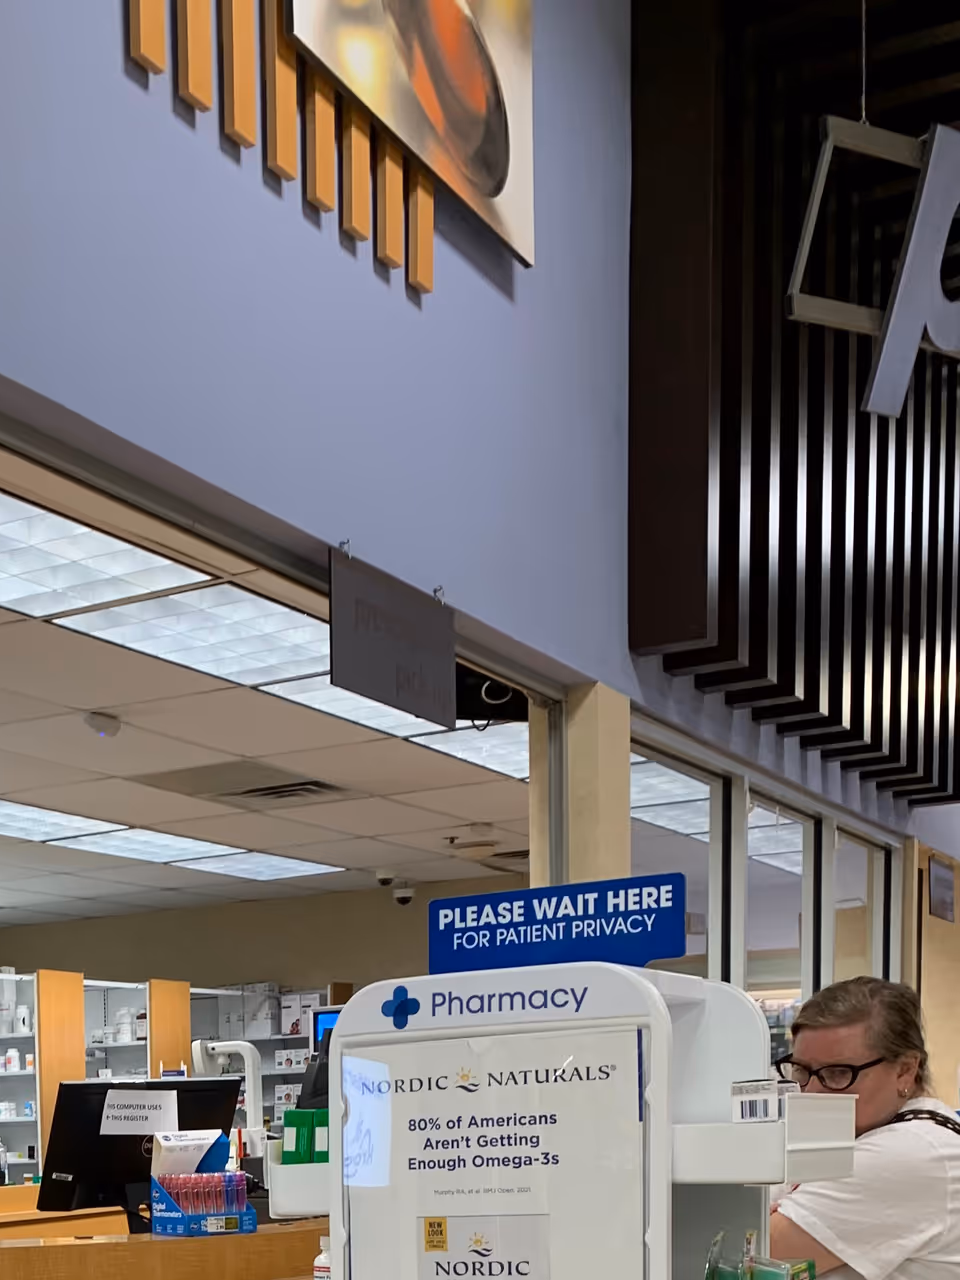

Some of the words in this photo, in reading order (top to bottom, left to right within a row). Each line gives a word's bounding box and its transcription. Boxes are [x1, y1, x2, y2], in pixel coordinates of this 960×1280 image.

[439, 900, 525, 930] PLEASE
[532, 893, 598, 920] WAIT
[607, 885, 673, 913] HERE
[453, 930, 490, 950] FOR
[496, 922, 566, 946] PATIENT
[572, 913, 656, 939] PRIVACY
[431, 986, 589, 1017] Pharmacy
[361, 1075, 449, 1096] NORDIC
[408, 1117, 441, 1132] 80%
[446, 1116, 463, 1130] of
[468, 1112, 558, 1129] Americans
[423, 1135, 471, 1150] Aren't
[477, 1133, 540, 1150] Getting
[408, 1157, 466, 1172] Enough
[472, 1152, 560, 1169] Omega-3s
[428, 1221, 443, 1229] NEW
[434, 1260, 530, 1276] NORDIC
